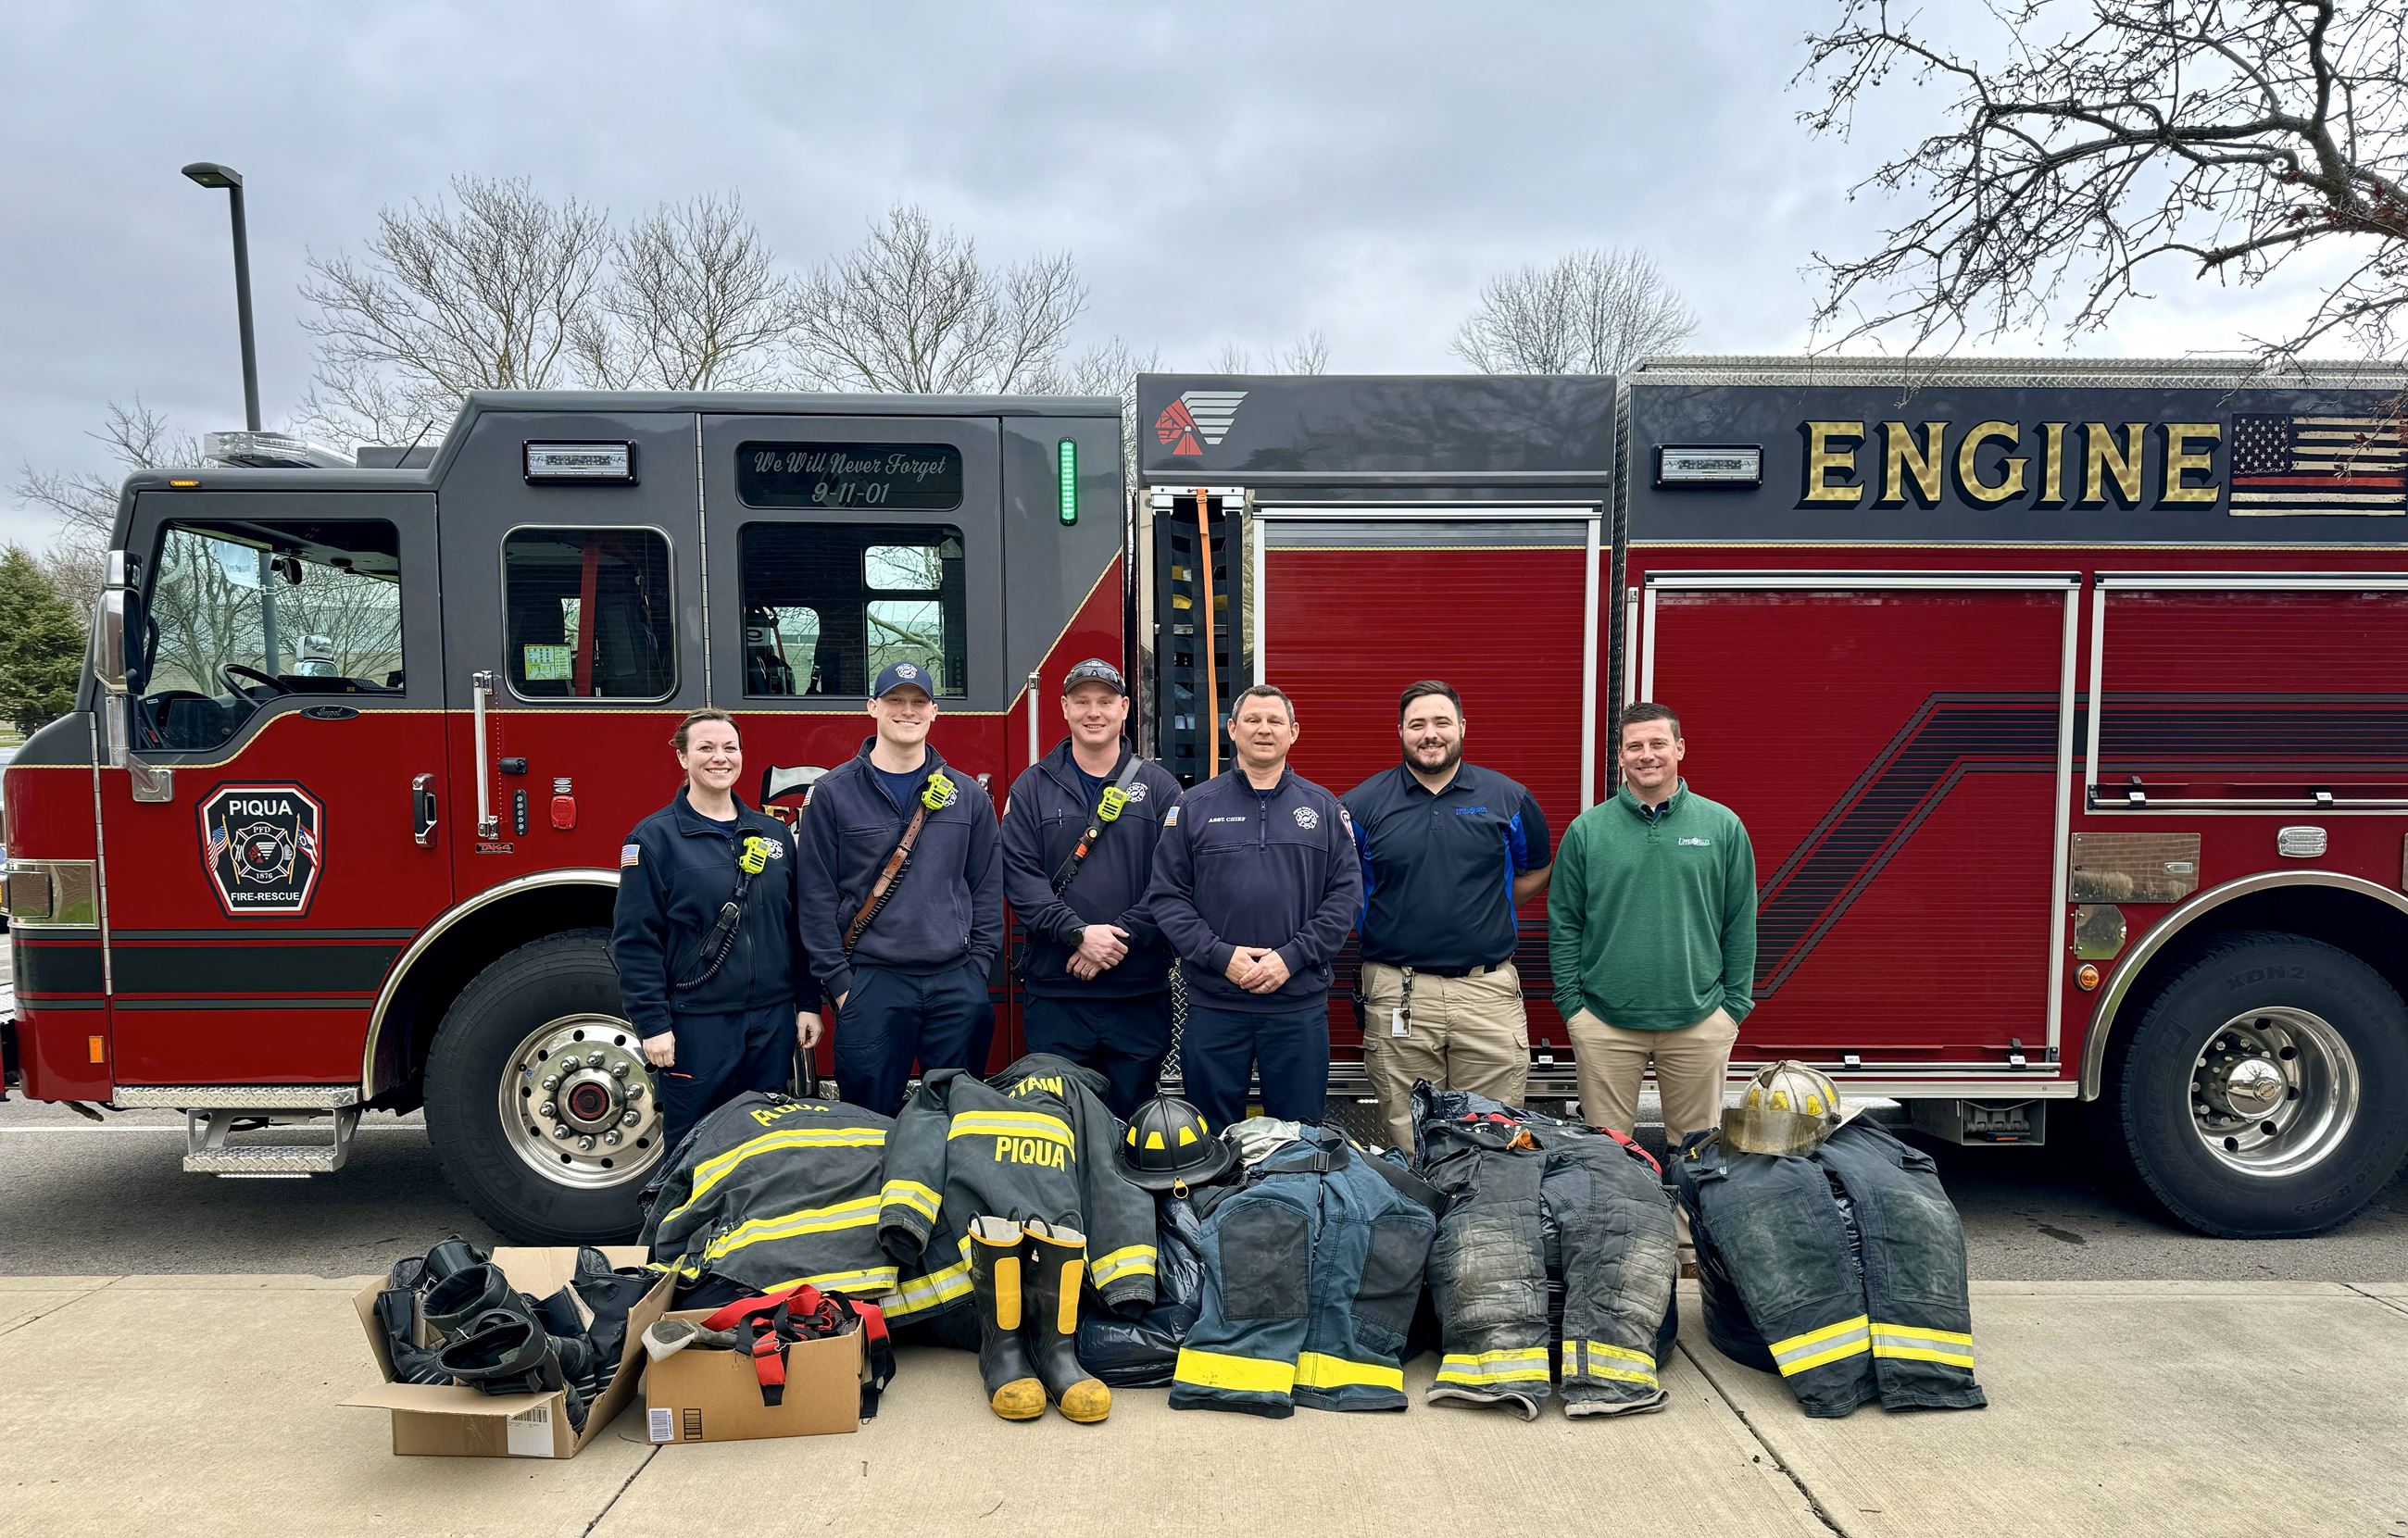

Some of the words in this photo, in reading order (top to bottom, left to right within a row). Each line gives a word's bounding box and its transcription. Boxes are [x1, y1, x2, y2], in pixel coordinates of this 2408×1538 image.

[754, 452, 783, 472] We
[786, 452, 825, 473] Will
[830, 453, 881, 474] Never
[885, 454, 947, 482] Forget
[1795, 419, 2224, 510] ENGINE
[811, 482, 890, 504] 9-11-01
[229, 800, 293, 817] PIQUA
[231, 892, 300, 902] FIRE-RESCUE
[995, 1136, 1065, 1172] PIQUA
